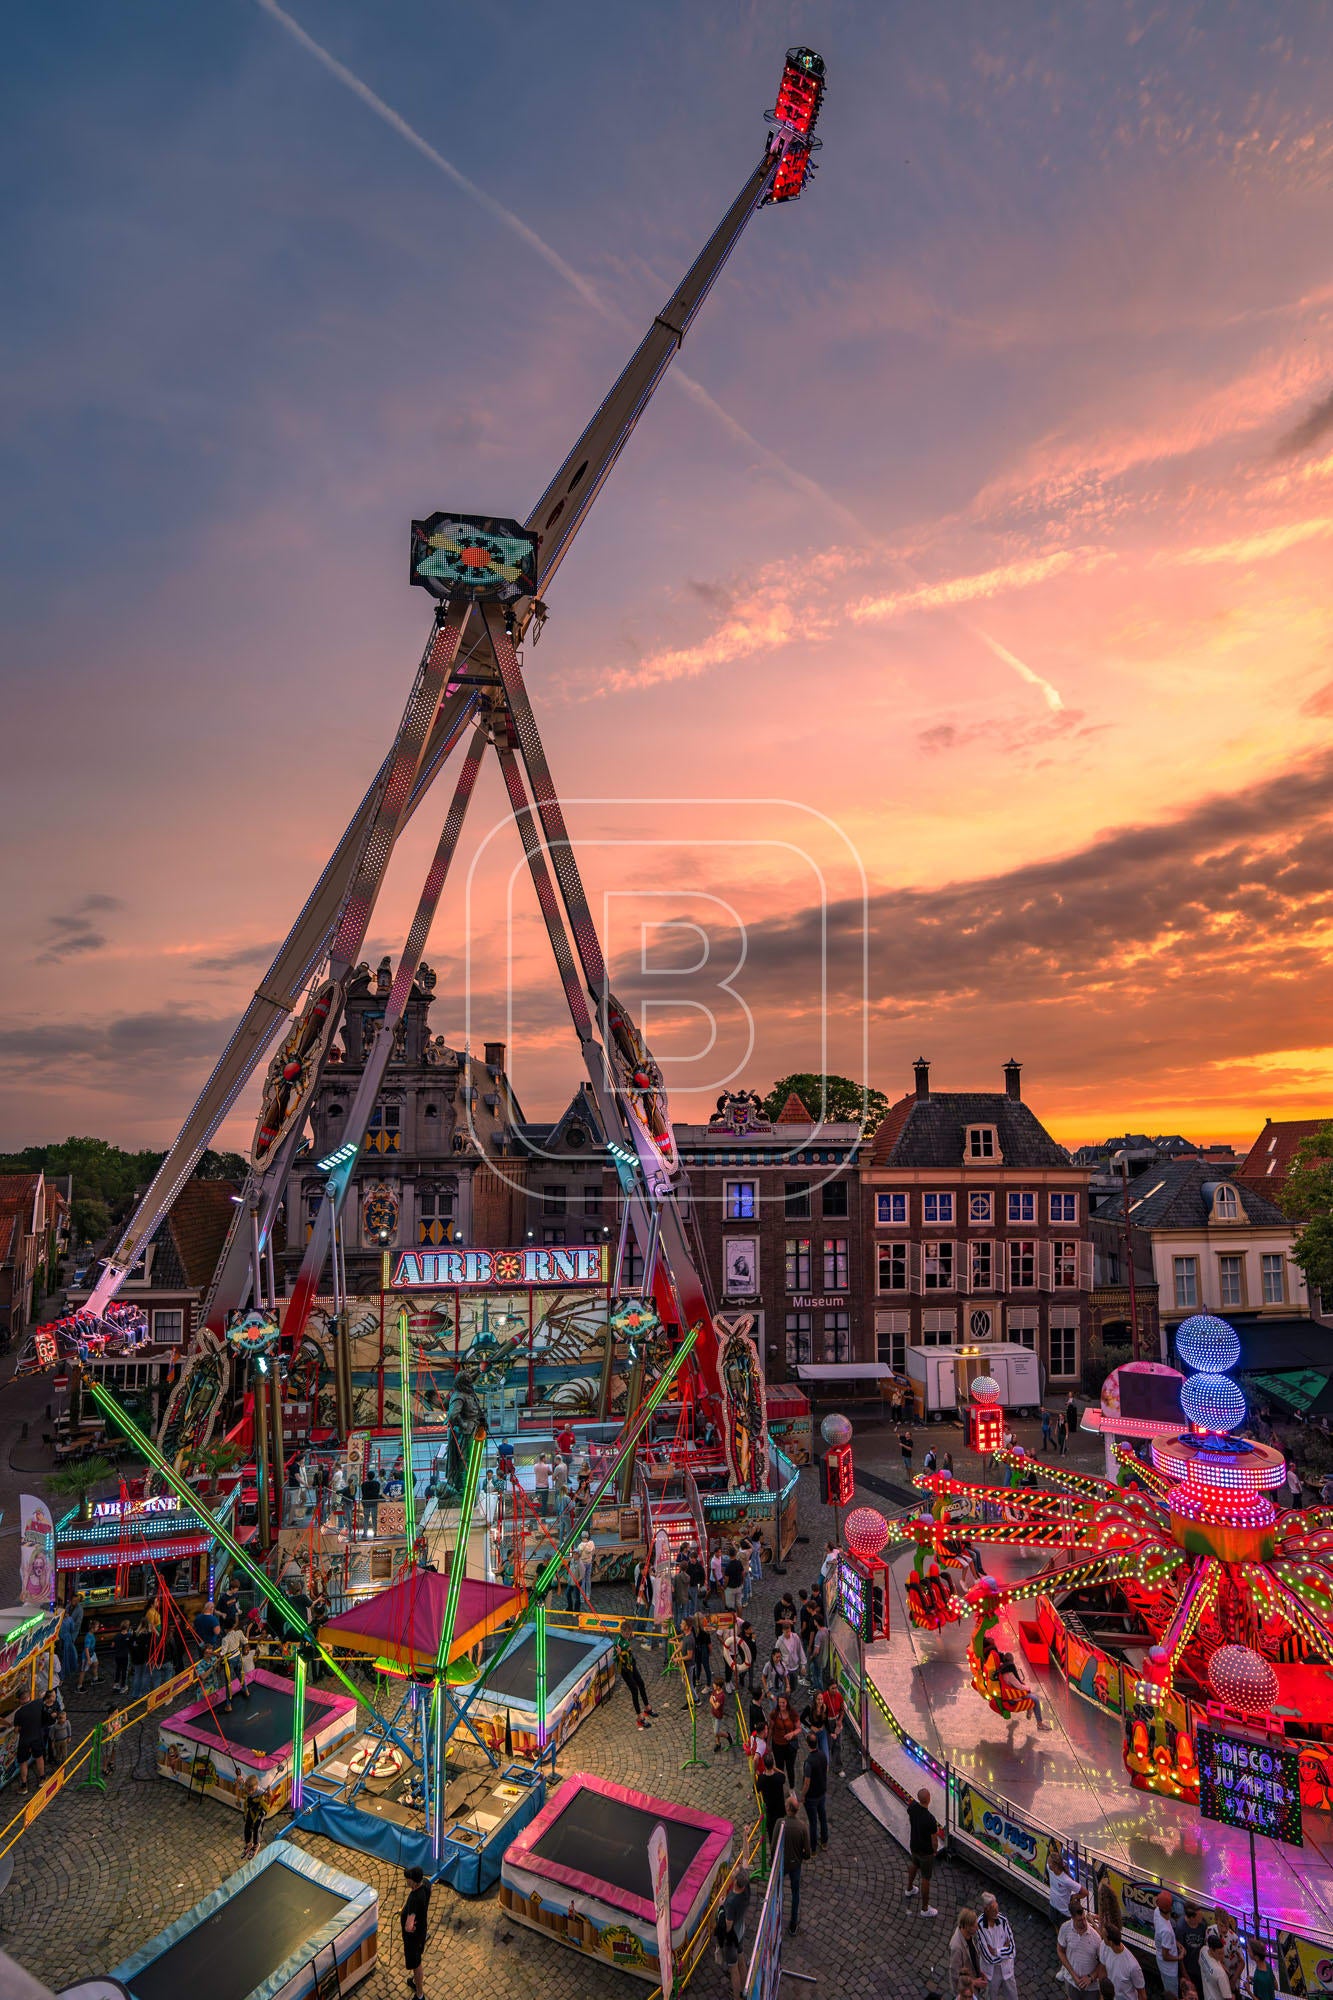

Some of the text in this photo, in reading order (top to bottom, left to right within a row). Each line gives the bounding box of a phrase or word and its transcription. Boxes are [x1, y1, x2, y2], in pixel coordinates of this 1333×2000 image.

[792, 1296, 844, 1308] Museum
[1221, 1741, 1273, 1775] DISCO
[1213, 1766, 1285, 1805] JUMPER
[983, 1811, 1003, 1836] GO
[1234, 1797, 1267, 1826] XXL
